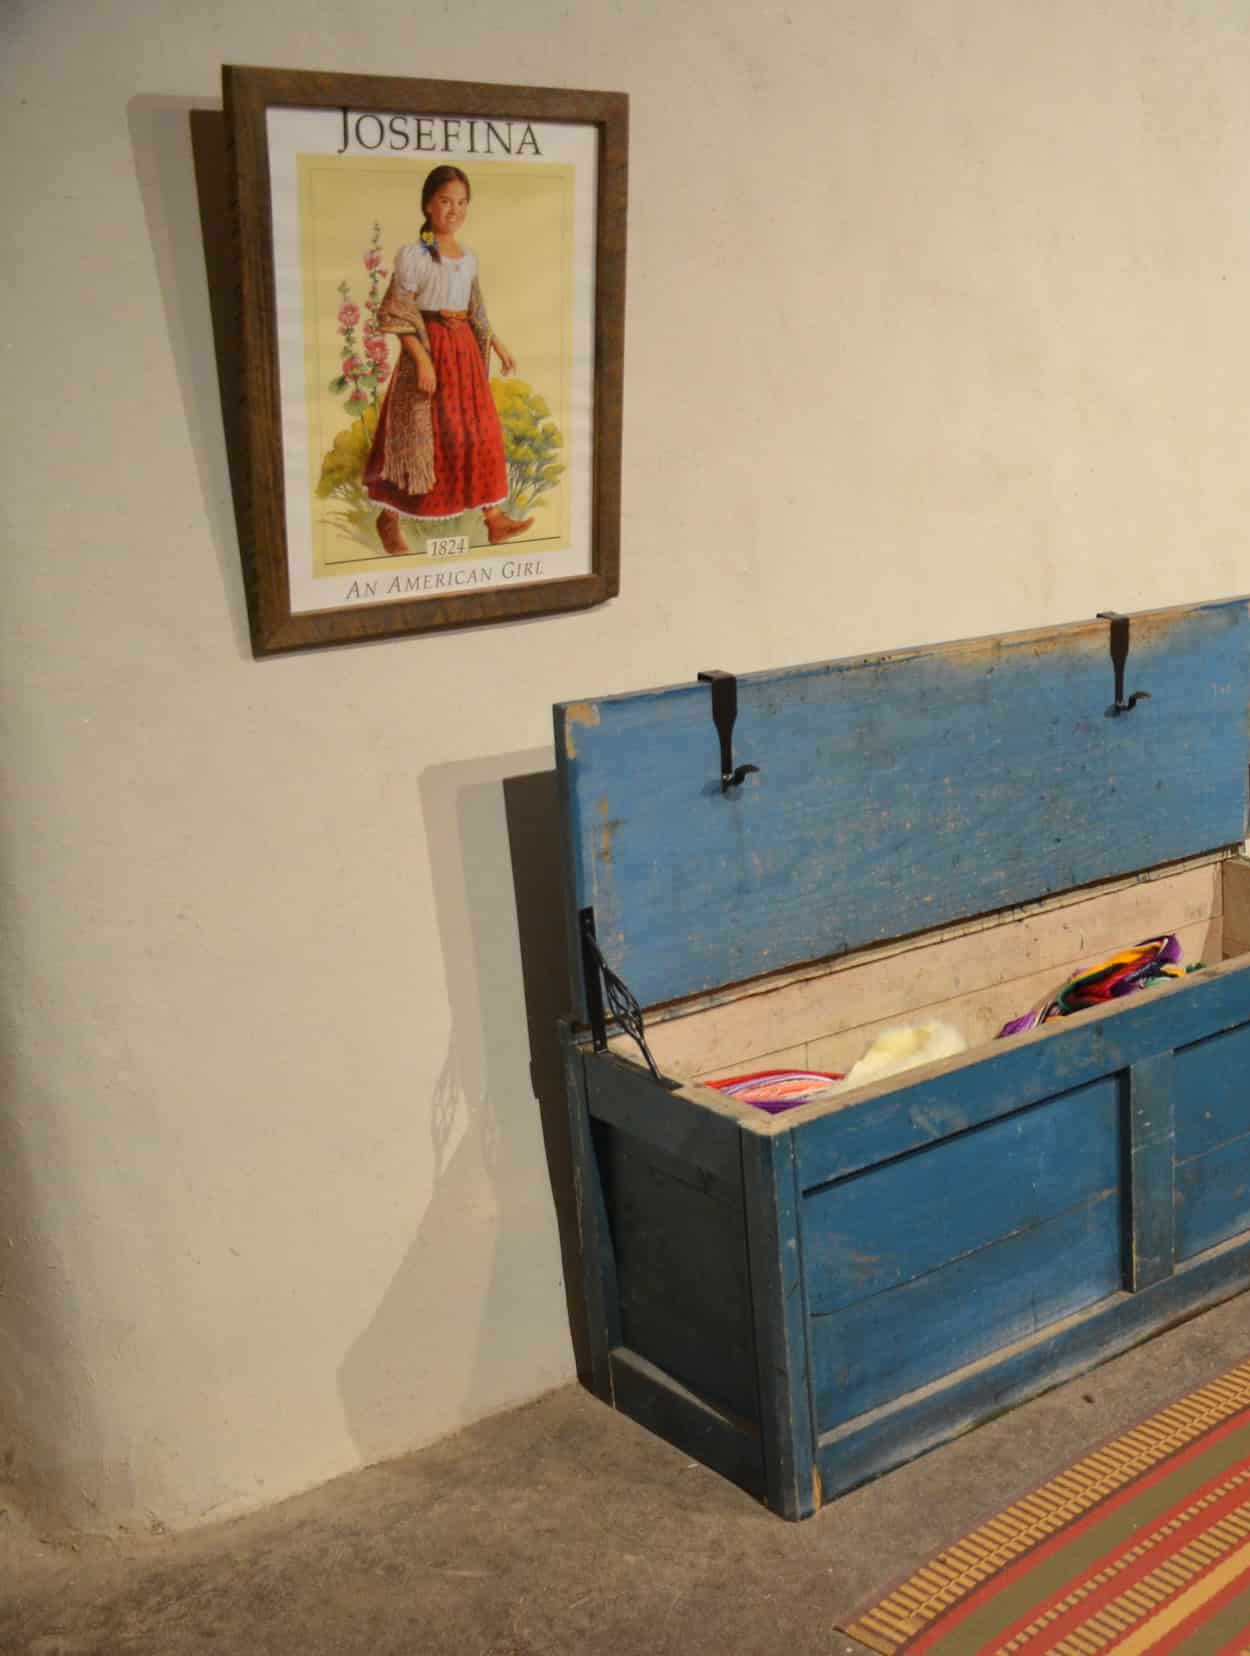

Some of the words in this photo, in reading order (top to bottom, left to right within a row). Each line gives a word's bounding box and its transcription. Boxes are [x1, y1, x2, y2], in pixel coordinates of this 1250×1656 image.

[337, 107, 544, 154] JOSEFINA
[431, 539, 466, 556] 1824
[346, 580, 378, 600] AN
[387, 567, 493, 594] AMERICAN
[501, 560, 544, 580] GIRL
